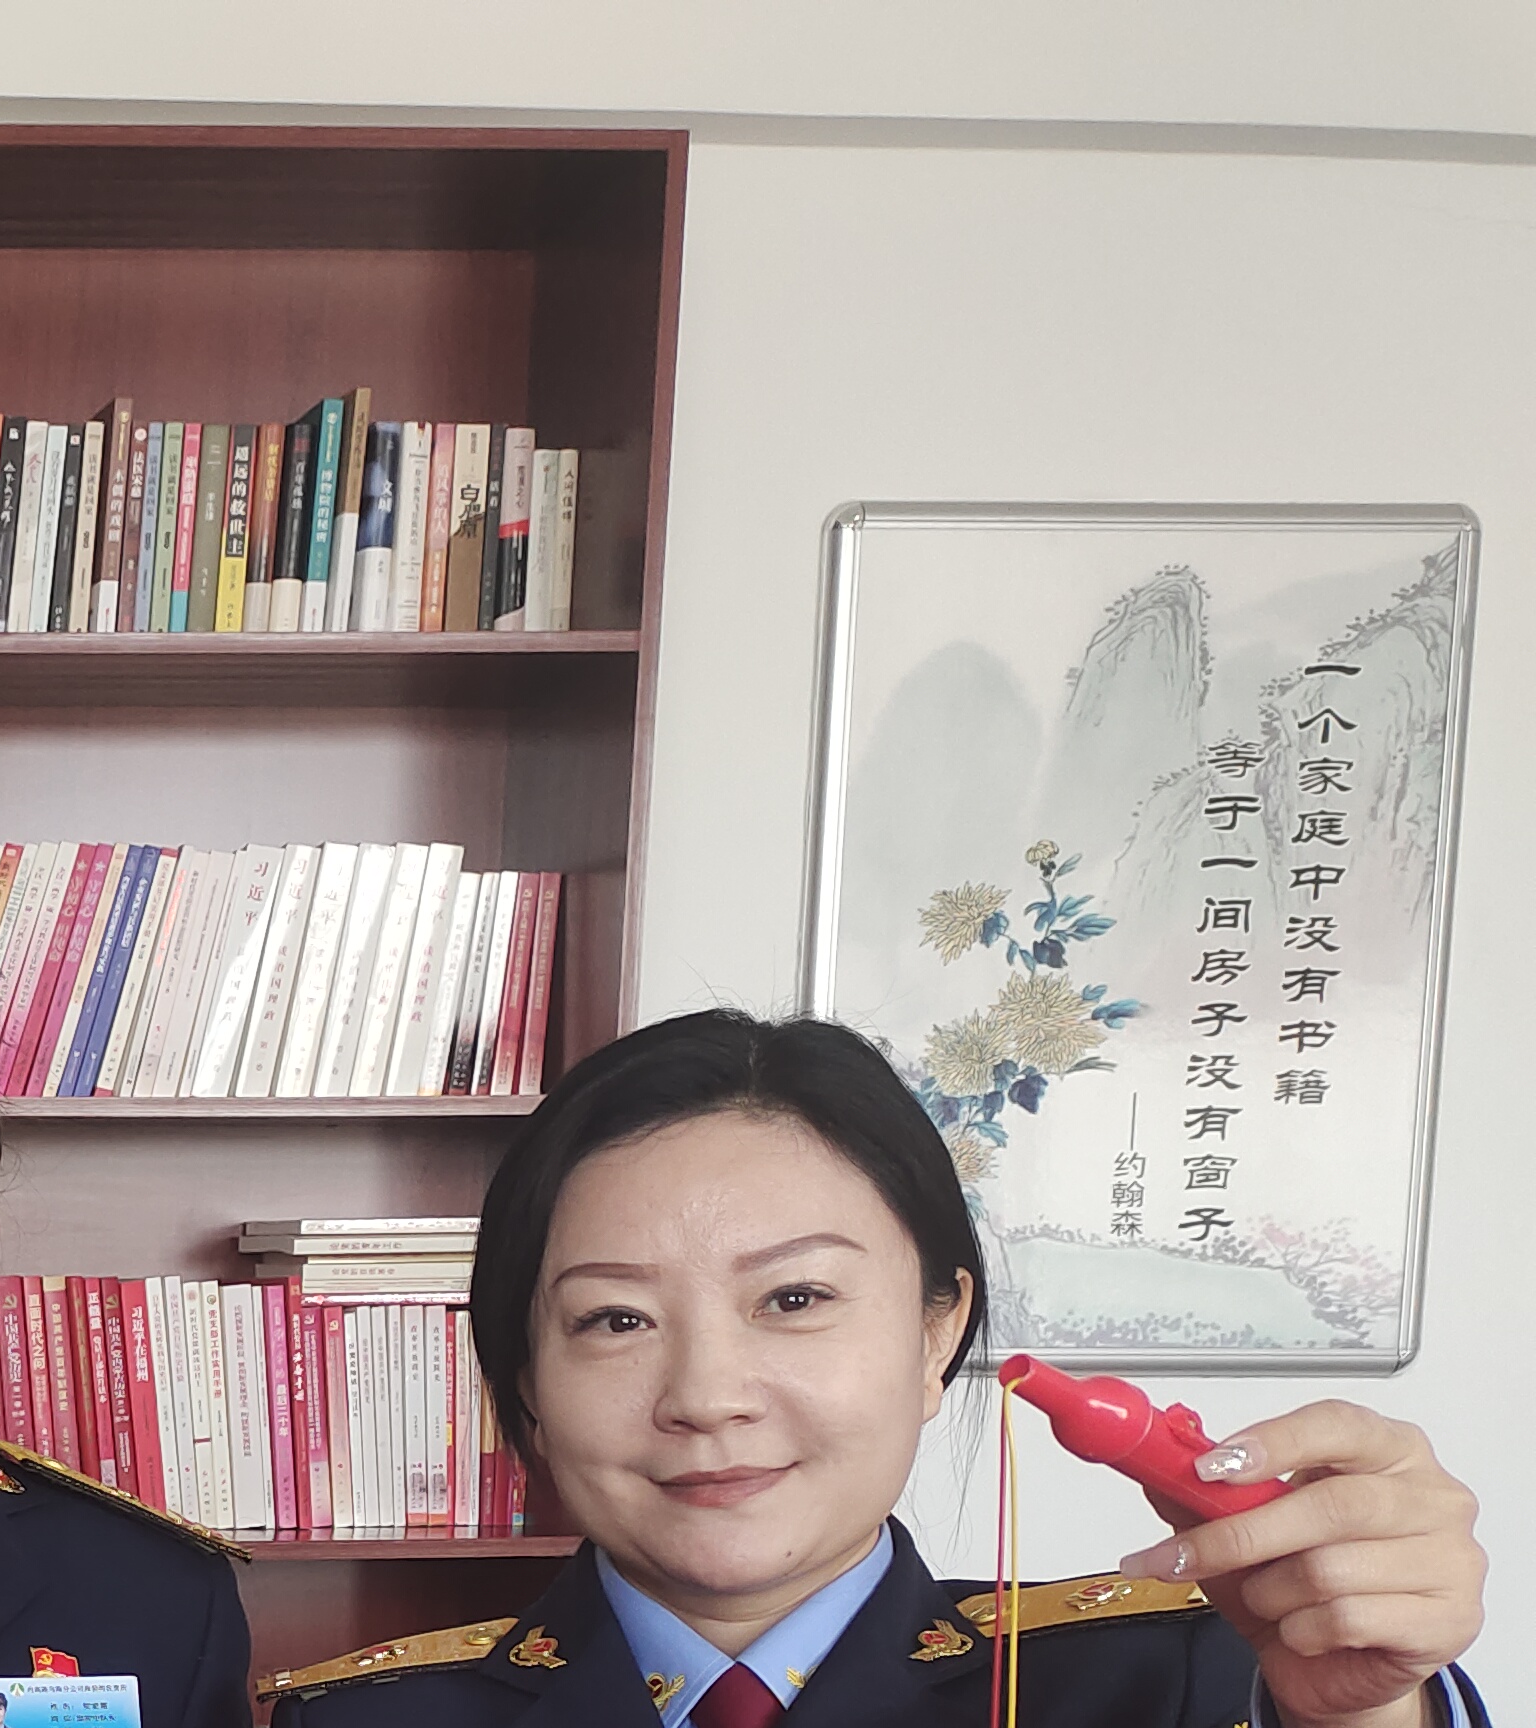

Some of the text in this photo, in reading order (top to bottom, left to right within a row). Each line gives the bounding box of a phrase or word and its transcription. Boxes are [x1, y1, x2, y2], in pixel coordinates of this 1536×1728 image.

[227, 446, 249, 556] 遥远的救世主
[378, 479, 393, 513] 文城
[458, 484, 481, 538] 白鹿原
[1274, 664, 1361, 1104] 一个家庭中没有书籍
[1178, 740, 1265, 1241] 等于一间房子没有窗子
[5, 1313, 23, 1382] 中国共产党历史
[208, 1309, 222, 1398] 党支部工作实用手册
